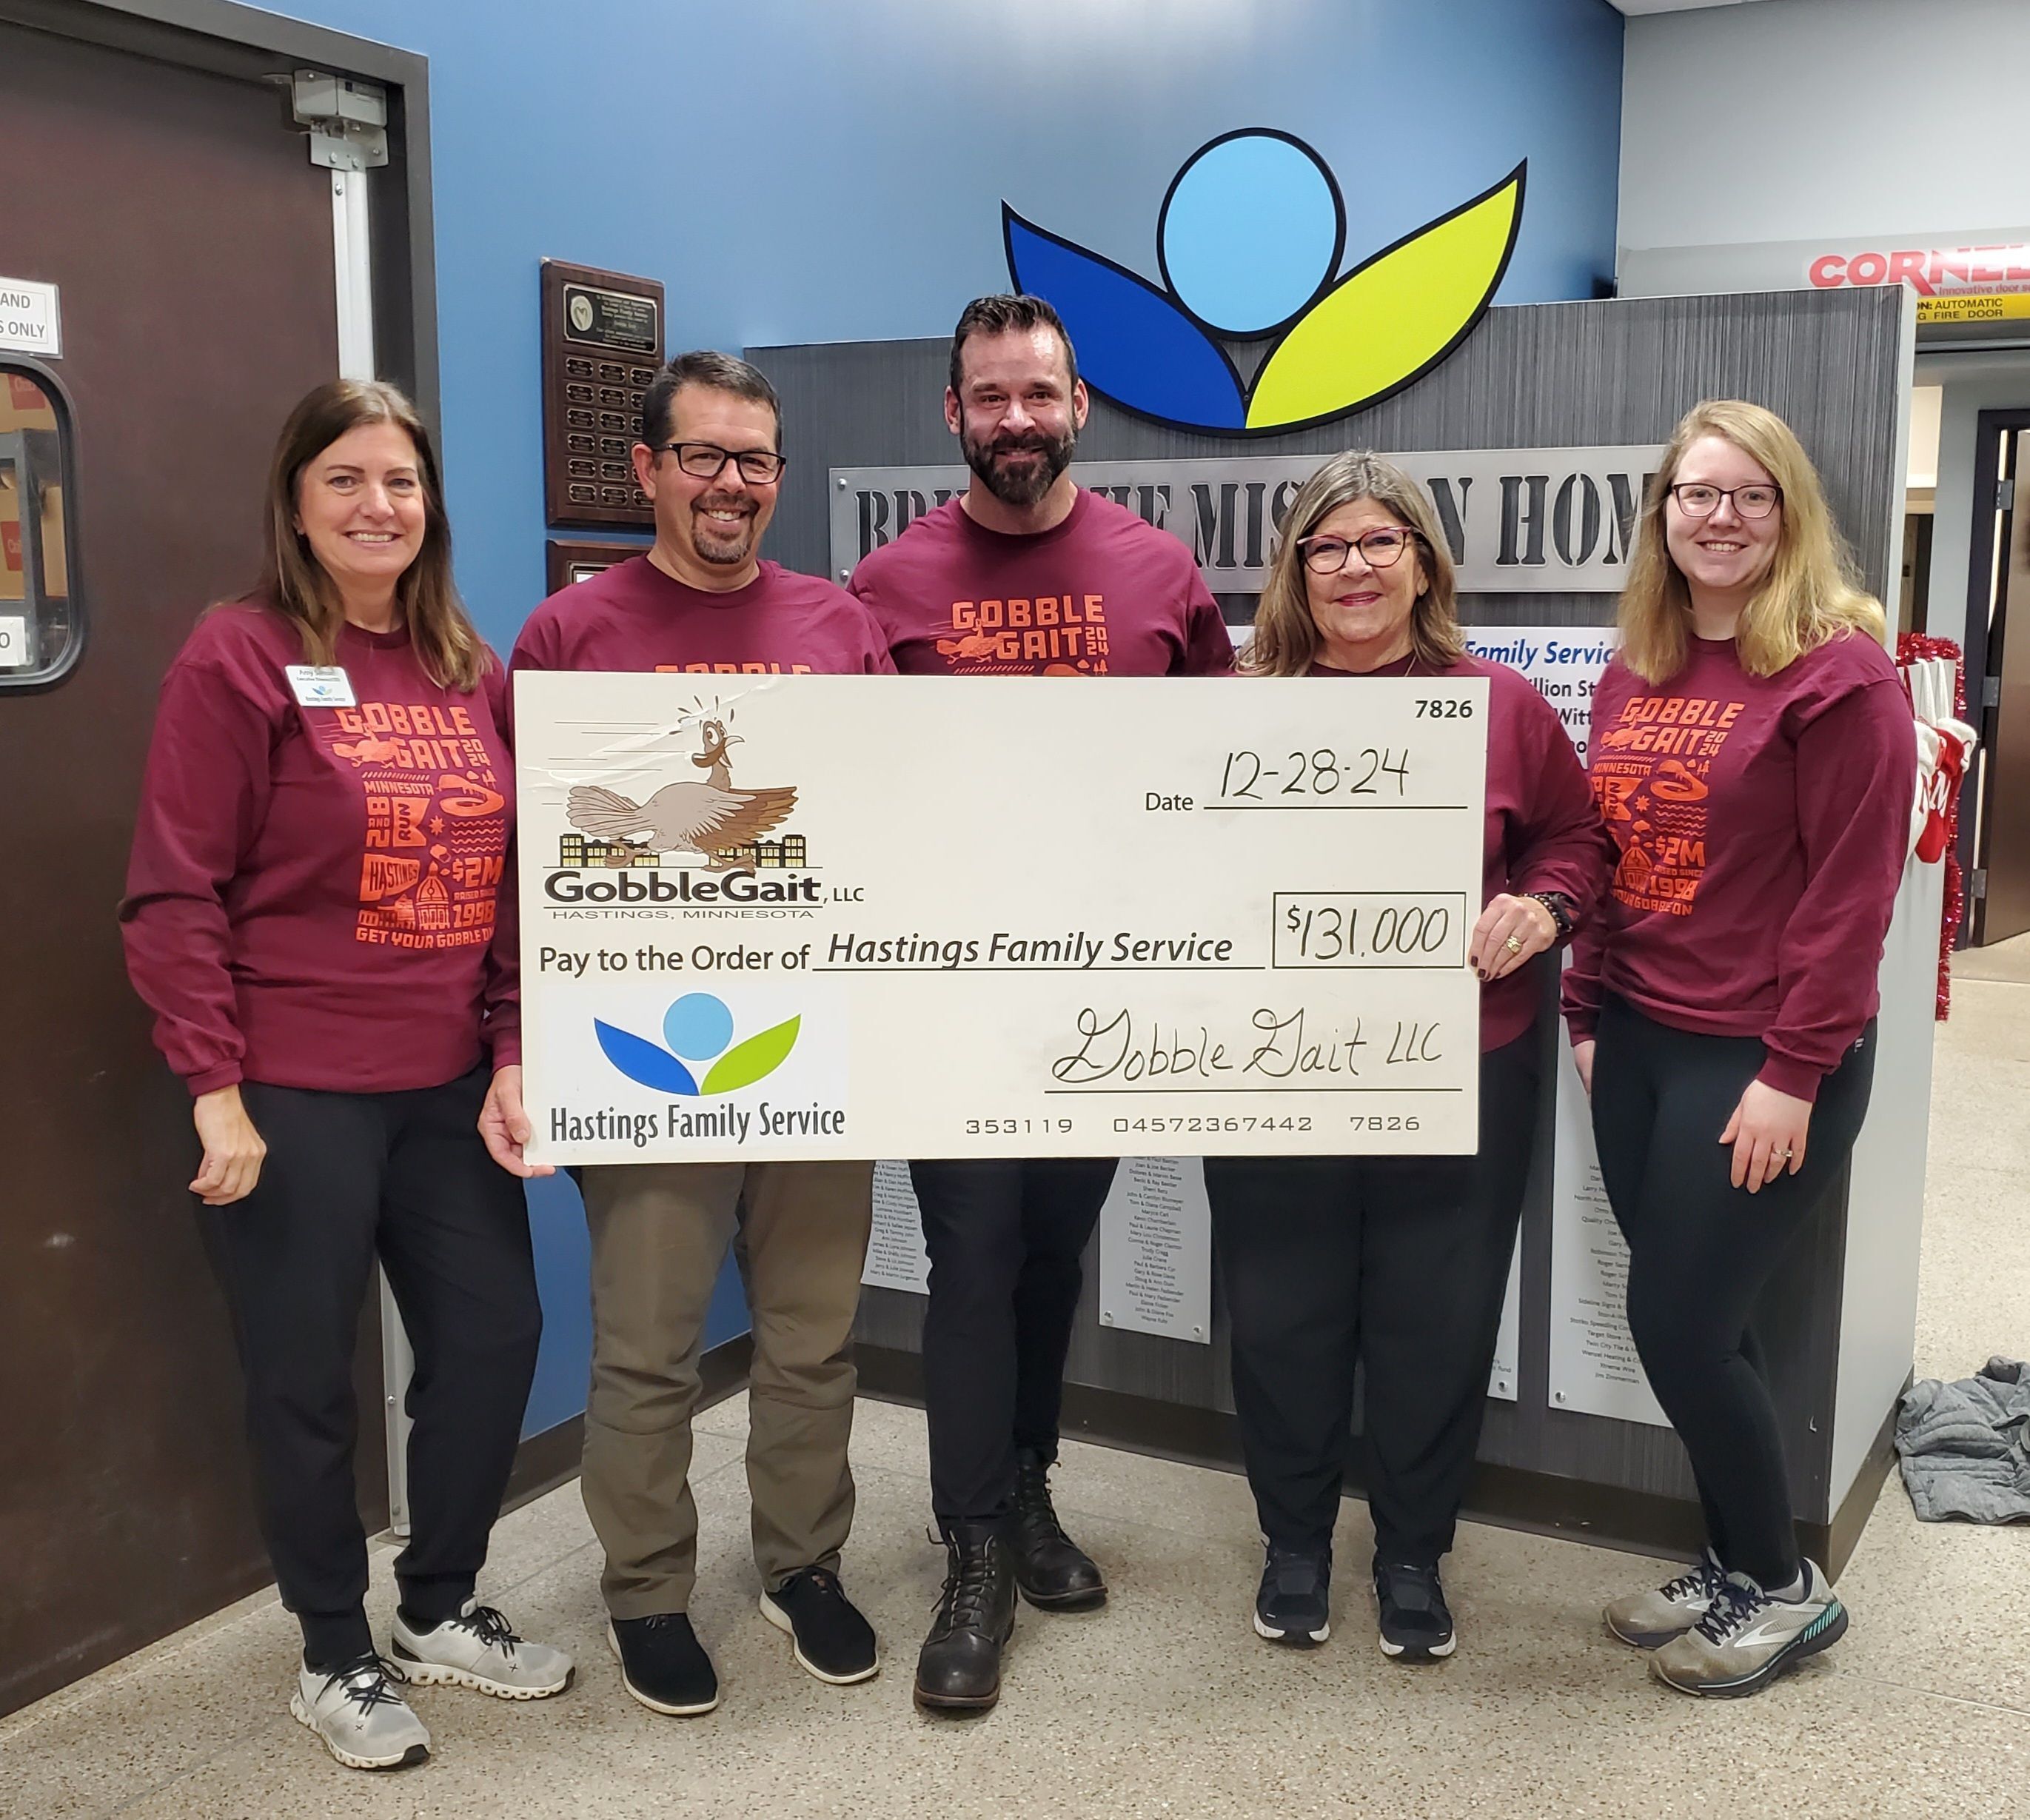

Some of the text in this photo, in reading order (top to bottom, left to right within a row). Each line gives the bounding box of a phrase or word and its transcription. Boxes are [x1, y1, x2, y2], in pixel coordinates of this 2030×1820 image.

[1939, 285, 1993, 295] Innovative
[1996, 283, 2019, 293] door
[1934, 298, 2003, 310] AUTOMATIC
[1934, 311, 1960, 320] FIRE
[1967, 309, 2003, 318] DOOR
[8, 321, 45, 338] ONLY
[952, 595, 1105, 629] GOBBLE
[996, 626, 1082, 660] GAIT
[1544, 641, 1615, 664] Servic
[335, 702, 477, 736] GOBBLE
[1414, 700, 1473, 719] 7826
[1620, 697, 1745, 729] GOBBLE
[1630, 725, 1707, 755] GAIT
[392, 737, 463, 770] GAIT
[1593, 761, 1652, 777] MINNESOTA
[363, 780, 435, 796] MINNESOTA
[1145, 792, 1194, 812] Date
[367, 817, 390, 828] AND
[1655, 835, 1706, 867] $2M
[370, 860, 418, 892] HASTINGS
[452, 856, 504, 888] $2M
[833, 887, 865, 903] LLC
[1649, 875, 1699, 901] 1998
[452, 900, 496, 928] 1998
[552, 909, 815, 920] HASTINGS, MINNESOTA
[355, 927, 389, 944] GET
[391, 931, 434, 949] YOUR
[436, 931, 481, 948] GOBBLE
[540, 931, 1234, 979] Pay to the Order of Hastings Family Service
[1051, 1007, 1443, 1083] Gobble Gait LLC
[550, 1101, 845, 1148] Hastings Family Service
[965, 1115, 1421, 1134] 353119 04572367442 7826
